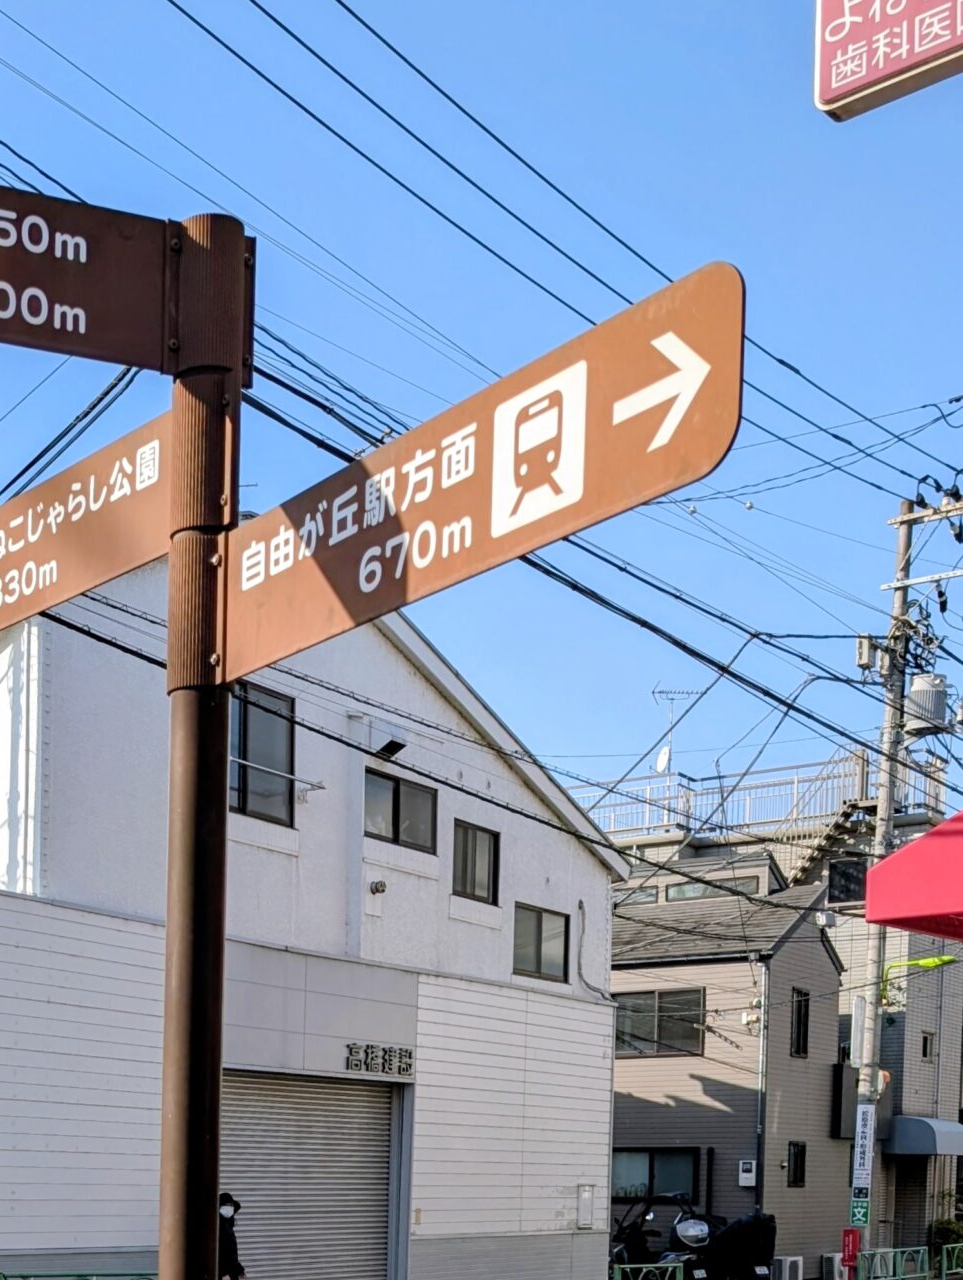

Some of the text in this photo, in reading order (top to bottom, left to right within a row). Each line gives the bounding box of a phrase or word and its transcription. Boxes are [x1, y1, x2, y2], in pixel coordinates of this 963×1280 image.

[240, 421, 477, 592] 自由が丘駅方面
[358, 516, 474, 595] 670m
[345, 1043, 413, 1076] 高橋建設
